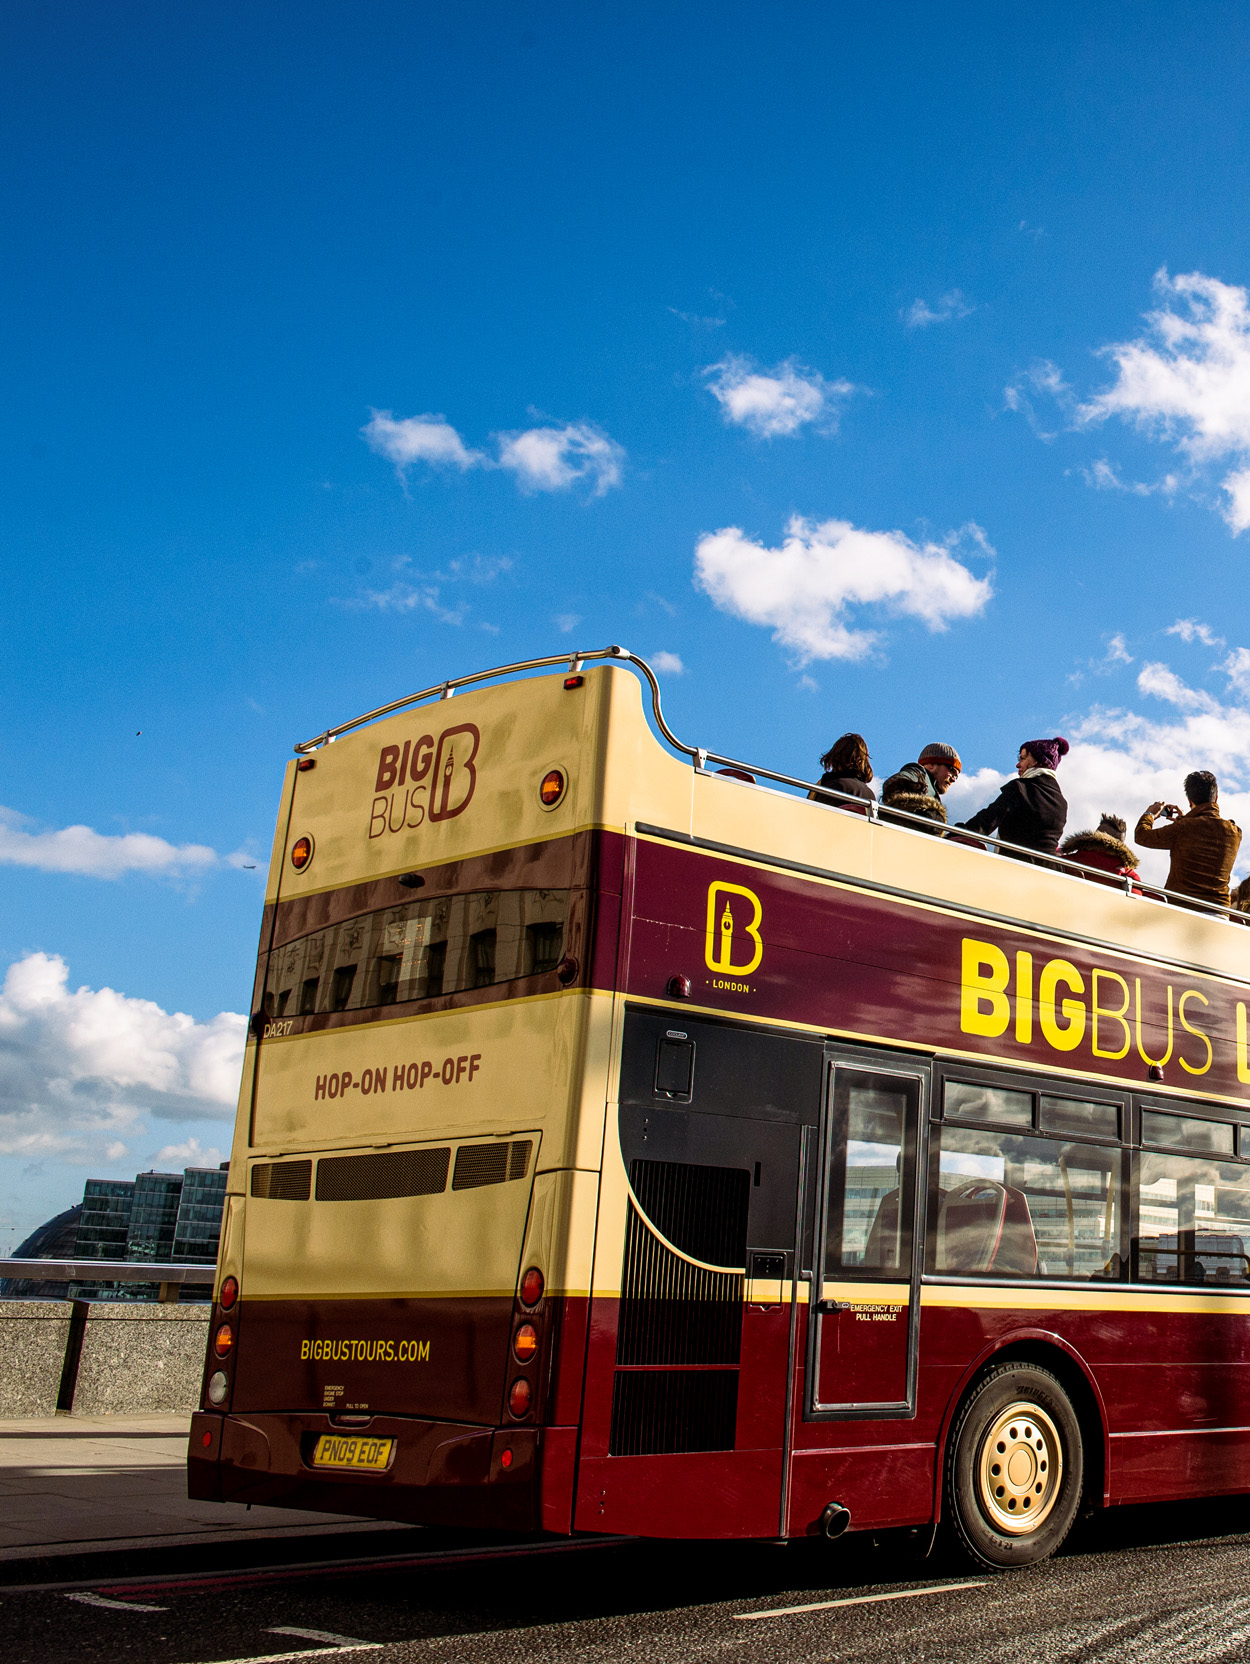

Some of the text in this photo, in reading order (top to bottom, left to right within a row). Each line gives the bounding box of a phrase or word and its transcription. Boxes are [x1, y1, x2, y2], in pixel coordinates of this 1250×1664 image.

[375, 734, 434, 793] BIG
[368, 785, 427, 840] BUS
[712, 979, 750, 994] LONDON
[264, 1020, 293, 1038] DA217
[315, 1053, 482, 1101] HOP-ON HOP-OFF
[850, 1304, 888, 1312] EMERGENCY
[889, 1305, 903, 1313] EXIT
[856, 1313, 897, 1321] PULL HANDLE
[300, 1339, 431, 1362] BIGBUSTOURS.COM
[320, 1439, 357, 1462] PN09
